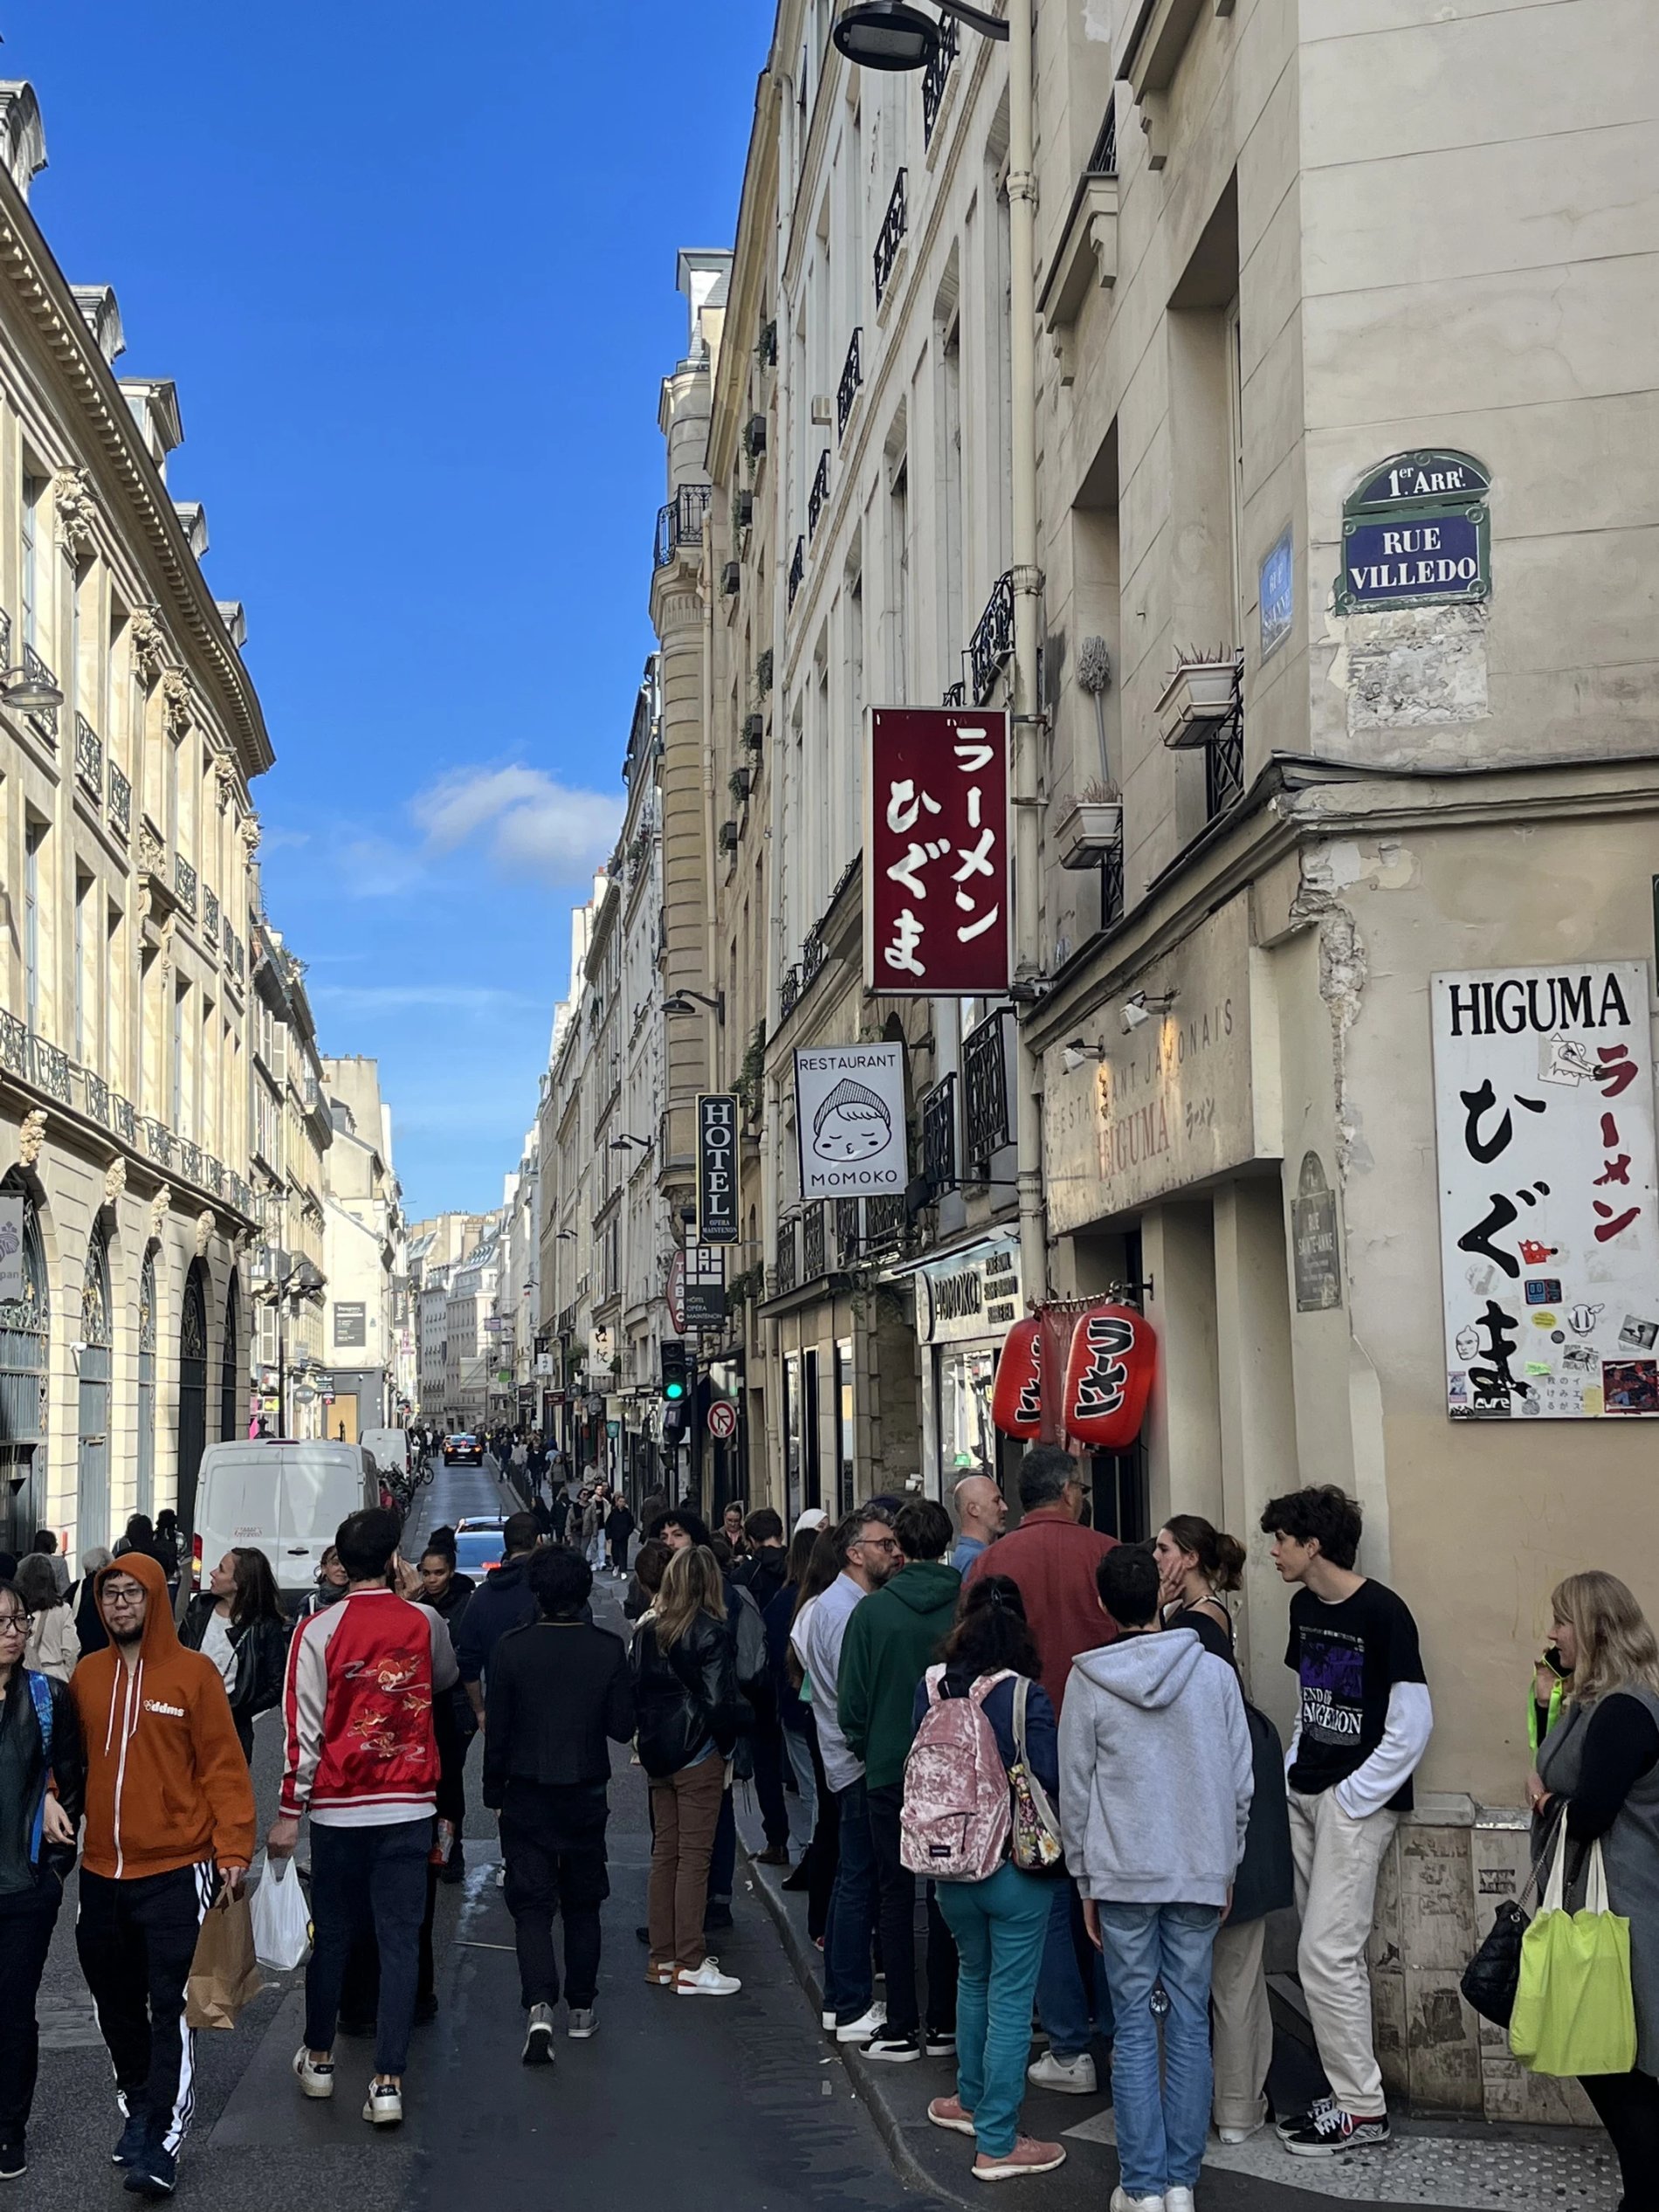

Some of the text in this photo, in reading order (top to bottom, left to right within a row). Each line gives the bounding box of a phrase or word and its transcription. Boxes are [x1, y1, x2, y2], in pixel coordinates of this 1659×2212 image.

[1349, 557, 1477, 589] VILLEDO
[1383, 527, 1441, 555] RUE
[951, 727, 999, 943] ラーメン
[885, 779, 951, 977] ひぐま
[1449, 972, 1631, 1037] HIGUMA
[800, 1054, 897, 1072] RESTAURANT
[704, 1104, 732, 1216] HOTEL
[1098, 1097, 1170, 1181] HIGUMA
[1593, 1044, 1642, 1244] ラーメン
[811, 1169, 898, 1187] MOMOKO
[1456, 1078, 1551, 1400] ひぐま
[675, 1262, 685, 1322] TABAC
[1074, 1317, 1134, 1419] ラーメン
[1303, 1687, 1324, 1702] END
